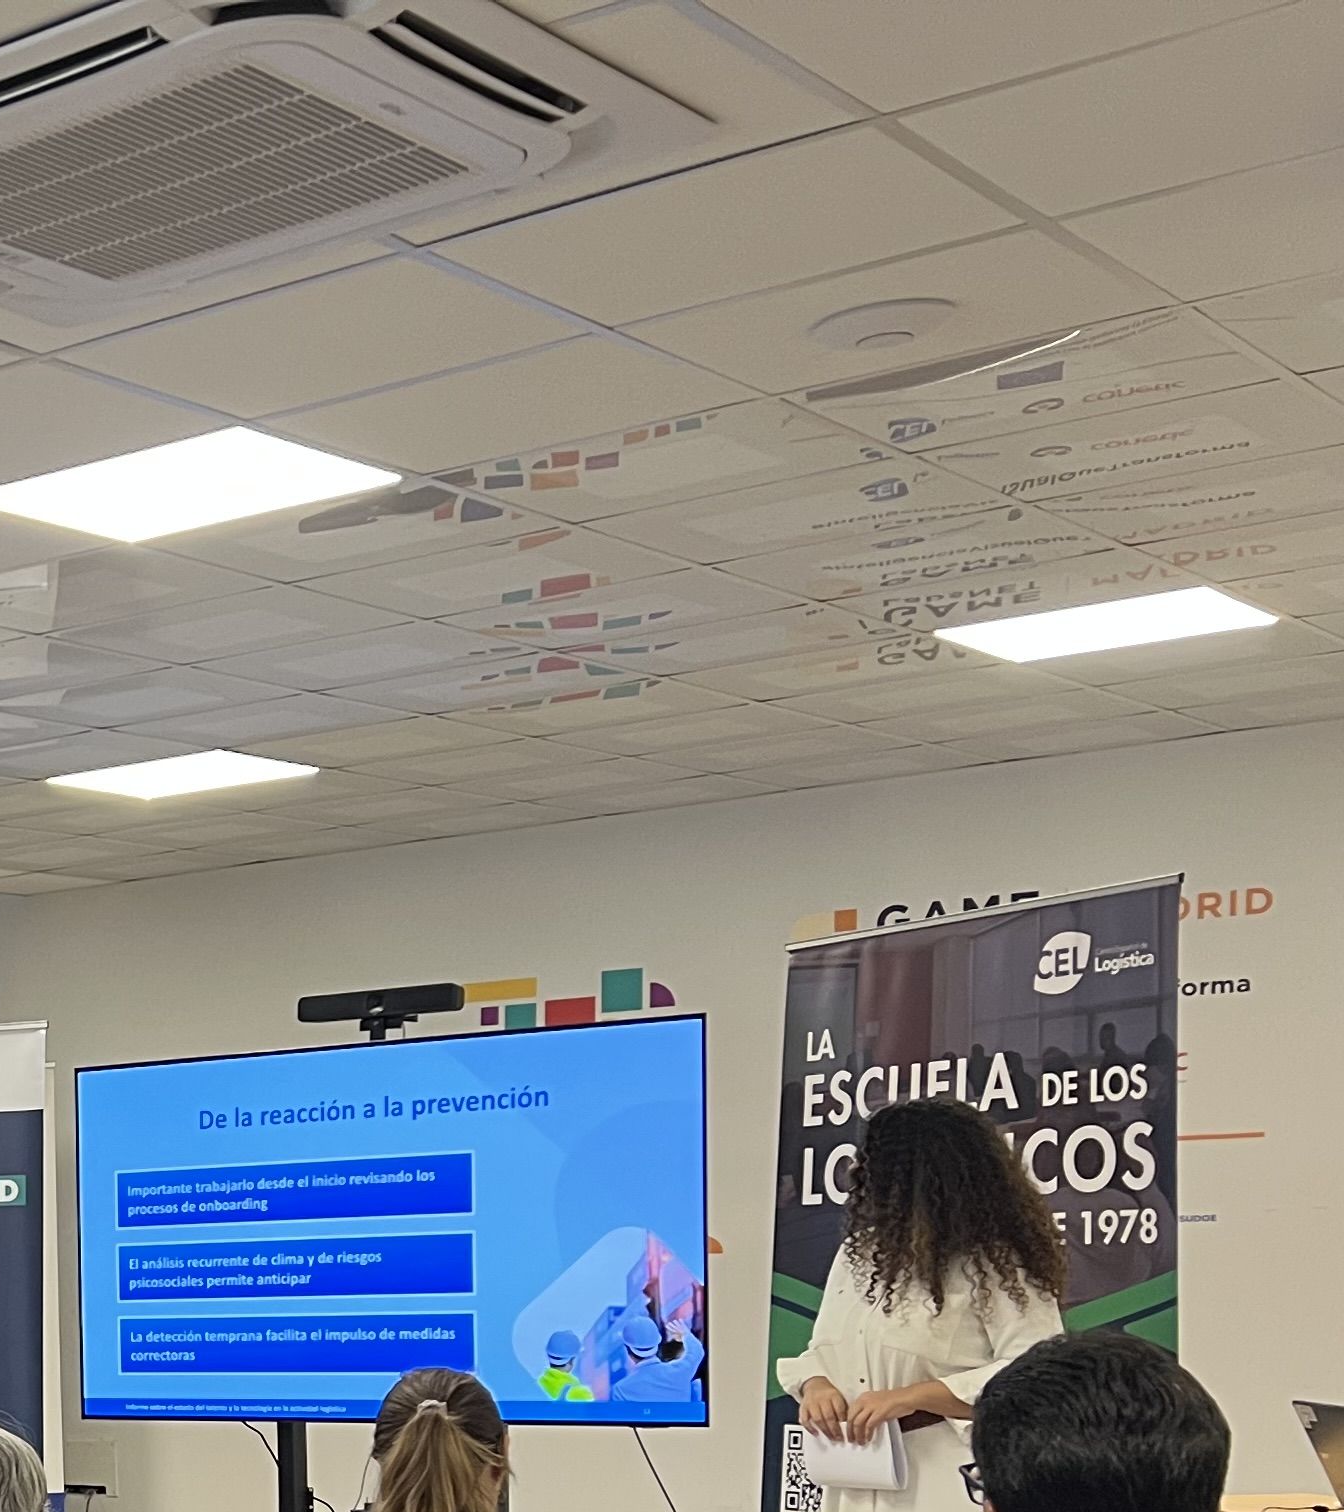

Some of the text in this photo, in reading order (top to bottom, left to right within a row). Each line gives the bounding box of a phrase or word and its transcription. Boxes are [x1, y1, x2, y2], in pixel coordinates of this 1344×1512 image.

[1039, 946, 1084, 980] CEL
[1095, 950, 1155, 975] Logística
[806, 1028, 835, 1062] LA
[1042, 1070, 1079, 1108] DE
[1090, 1063, 1148, 1104] LOS
[199, 1085, 549, 1130] De la reacción a la prevención
[128, 1169, 435, 1198] Importante trabajarlo desde el inicio revisando los
[127, 1197, 268, 1217] procesos de onboarding
[1081, 1208, 1158, 1246] 1978
[130, 1250, 382, 1270] El análisis recurrente de clima y de riesgos
[129, 1272, 311, 1290] psicosociales permite anticipar
[130, 1326, 456, 1344] La detección temprana facilita el impulso de medidas
[130, 1350, 195, 1362] correctoras
